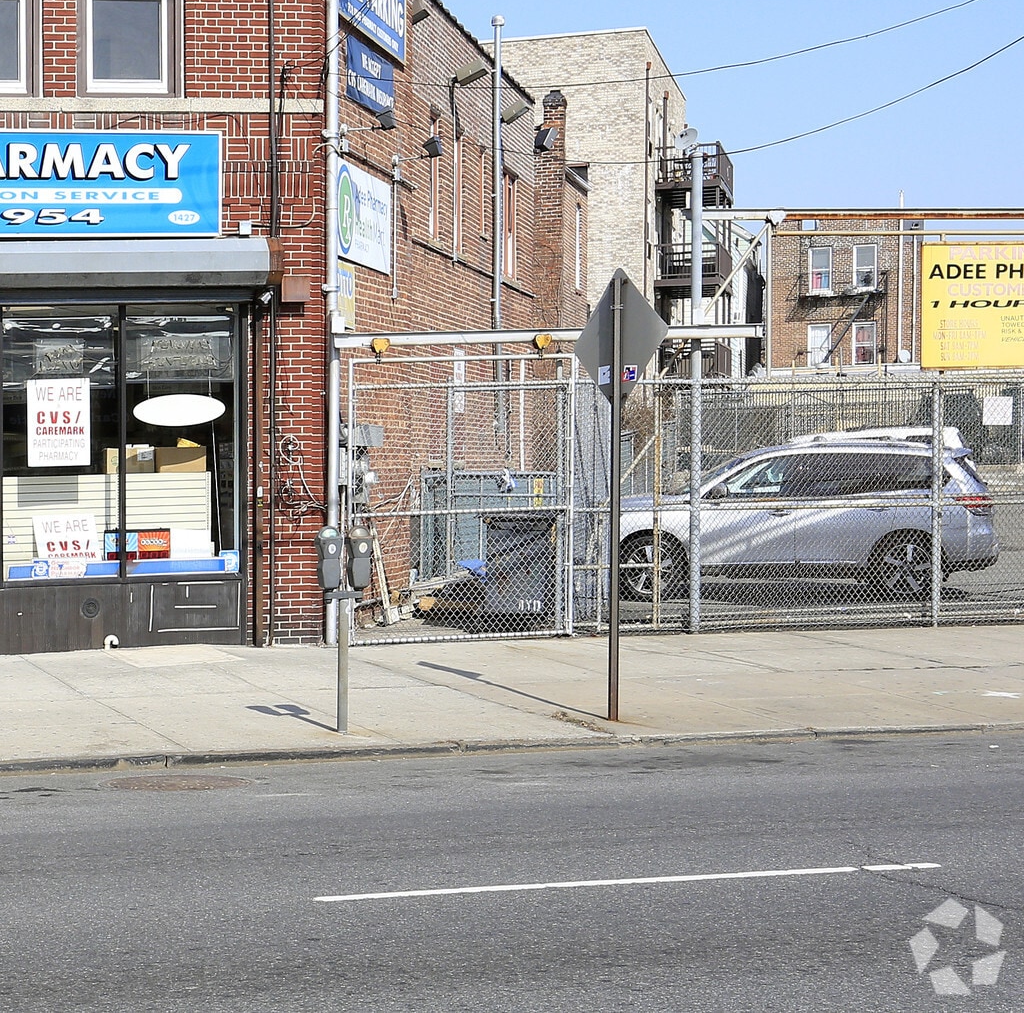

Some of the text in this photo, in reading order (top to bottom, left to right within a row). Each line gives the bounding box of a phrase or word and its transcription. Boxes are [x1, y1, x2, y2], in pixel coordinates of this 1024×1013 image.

[54, 191, 160, 200] SERVICE
[173, 213, 195, 222] 1427
[928, 263, 1024, 280] ADEE PH
[947, 283, 1024, 297] CUSTOM
[930, 300, 940, 309] 1
[36, 387, 54, 401] WE
[58, 386, 83, 402] ARE
[36, 426, 85, 436] CAREMARK
[33, 438, 86, 449] PARTICIPATING
[39, 451, 79, 461] PHARMACY
[42, 519, 90, 534] WE ARE
